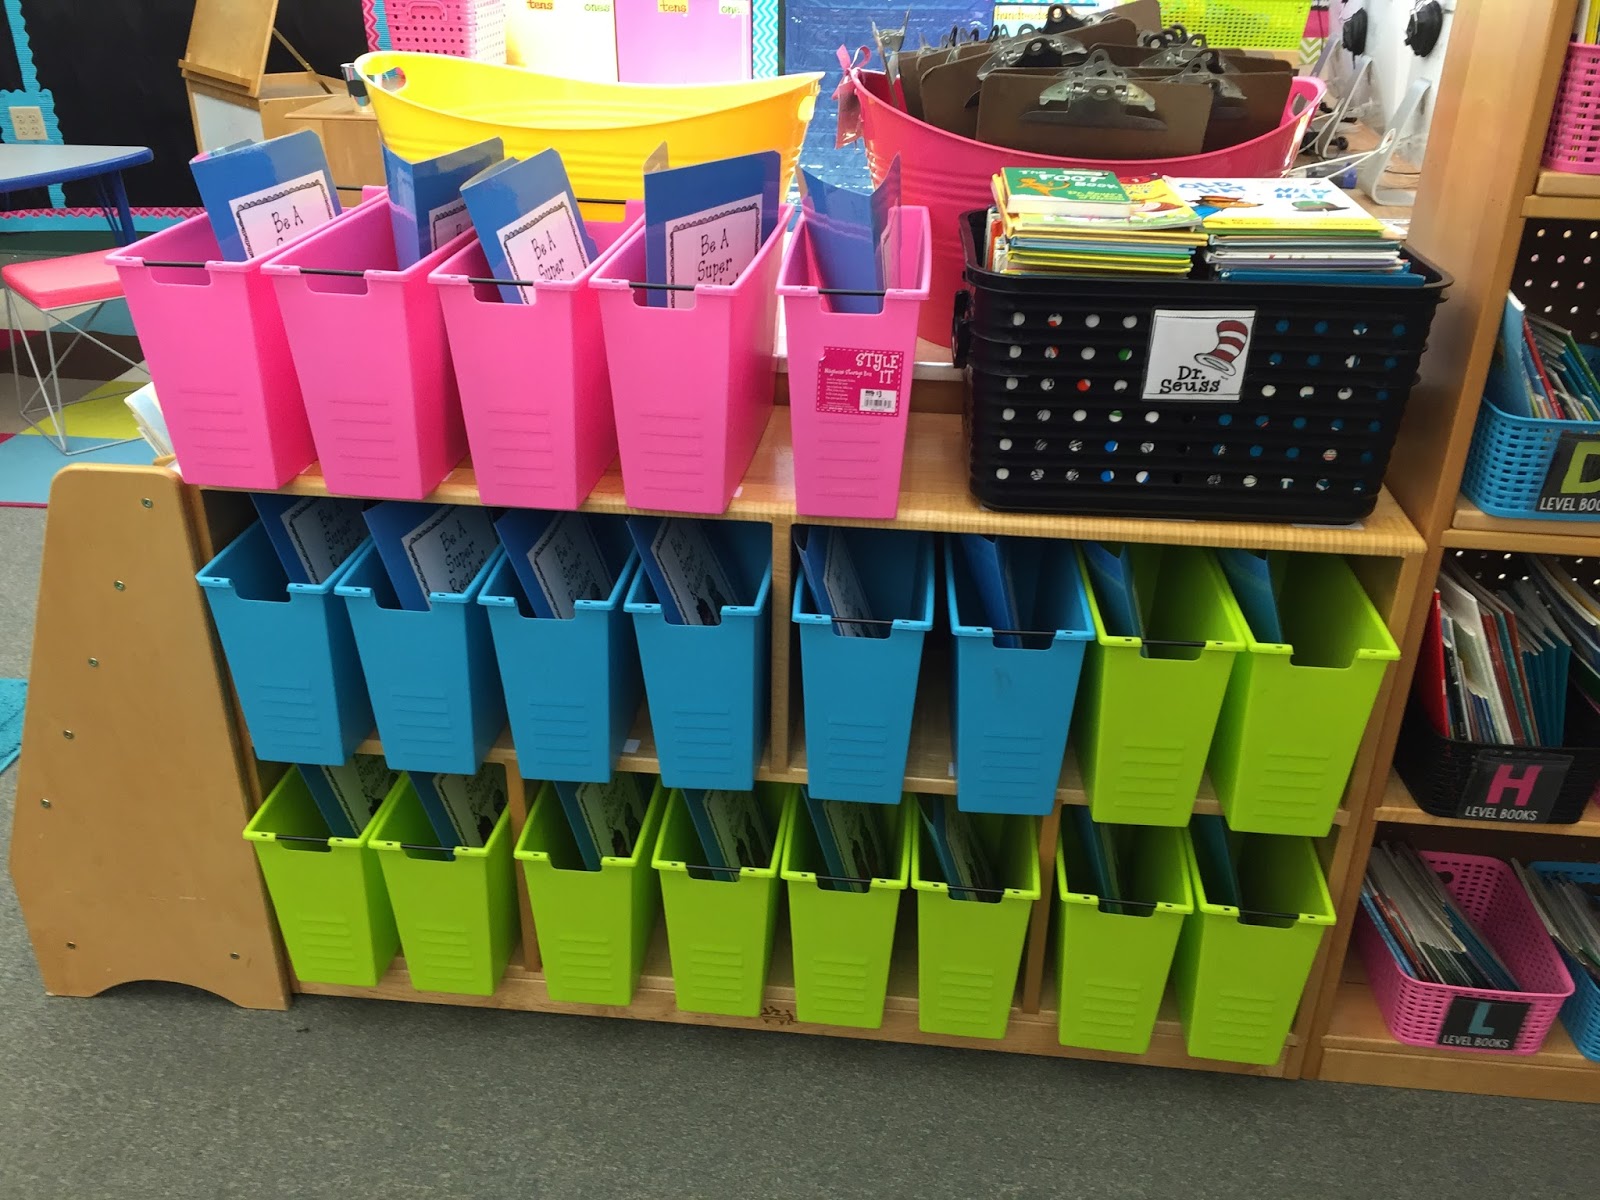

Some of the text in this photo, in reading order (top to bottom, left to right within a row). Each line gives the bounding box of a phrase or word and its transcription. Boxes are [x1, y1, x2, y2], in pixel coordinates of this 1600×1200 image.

[526, 0, 553, 10] tens
[659, 0, 687, 12] tens
[271, 205, 304, 233] Be A
[531, 230, 557, 260] Be A
[700, 227, 730, 257] Be A
[697, 257, 733, 282] Super
[855, 352, 899, 371] STYLE
[1178, 365, 1207, 381] Dr.
[1159, 379, 1221, 395] Seuss
[1539, 496, 1576, 511] LEVEL
[440, 519, 468, 552] Be A
[445, 540, 475, 574] Super
[1485, 764, 1543, 807] H
[1465, 806, 1538, 821] LEVEL BOOKS
[1468, 1001, 1495, 1036] L
[1442, 1034, 1510, 1049] LEVEL BOOKS
